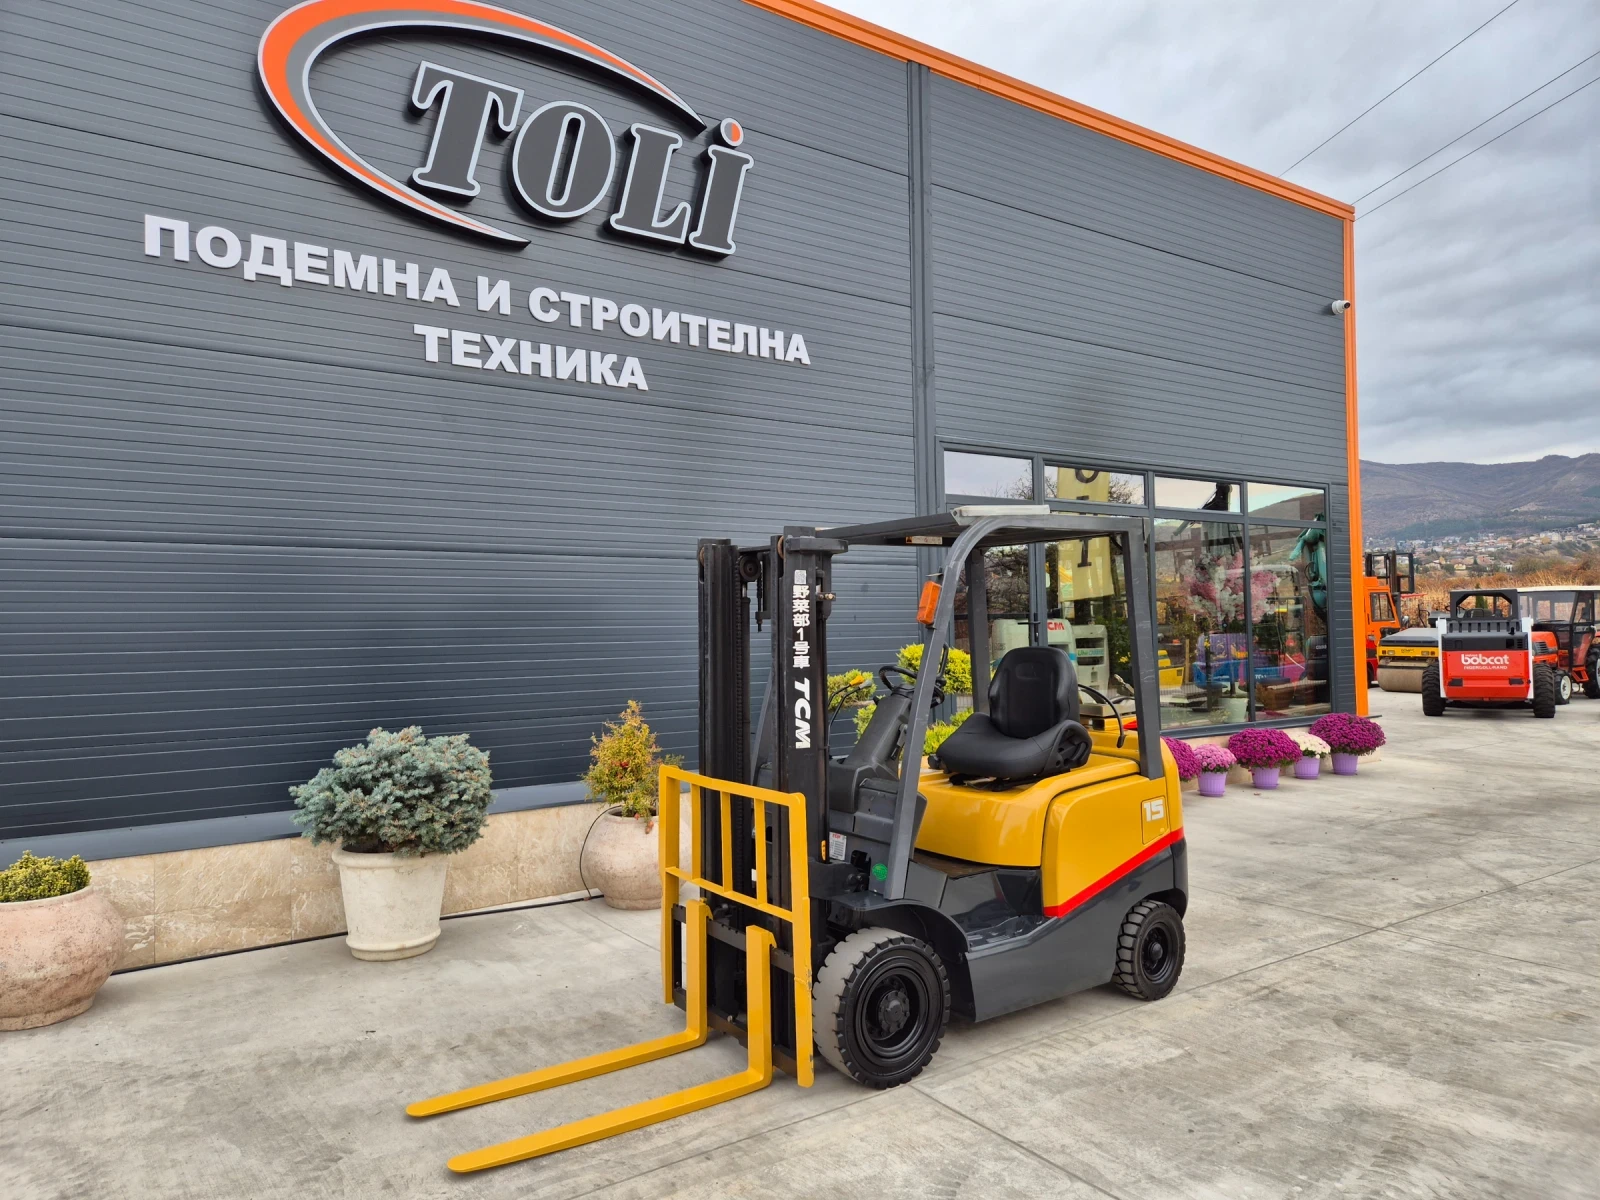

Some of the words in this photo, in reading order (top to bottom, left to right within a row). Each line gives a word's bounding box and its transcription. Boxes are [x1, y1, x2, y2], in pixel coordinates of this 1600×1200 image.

[144, 214, 461, 306] ПОДЕМНА
[477, 275, 511, 314] И
[528, 287, 811, 365] СТРОИТЕЛНА
[413, 323, 649, 390] ТЕХНИКА
[1047, 621, 1064, 631] CM
[1461, 654, 1509, 665] bobcat
[794, 677, 811, 749] TCM
[1143, 799, 1165, 822] 15
